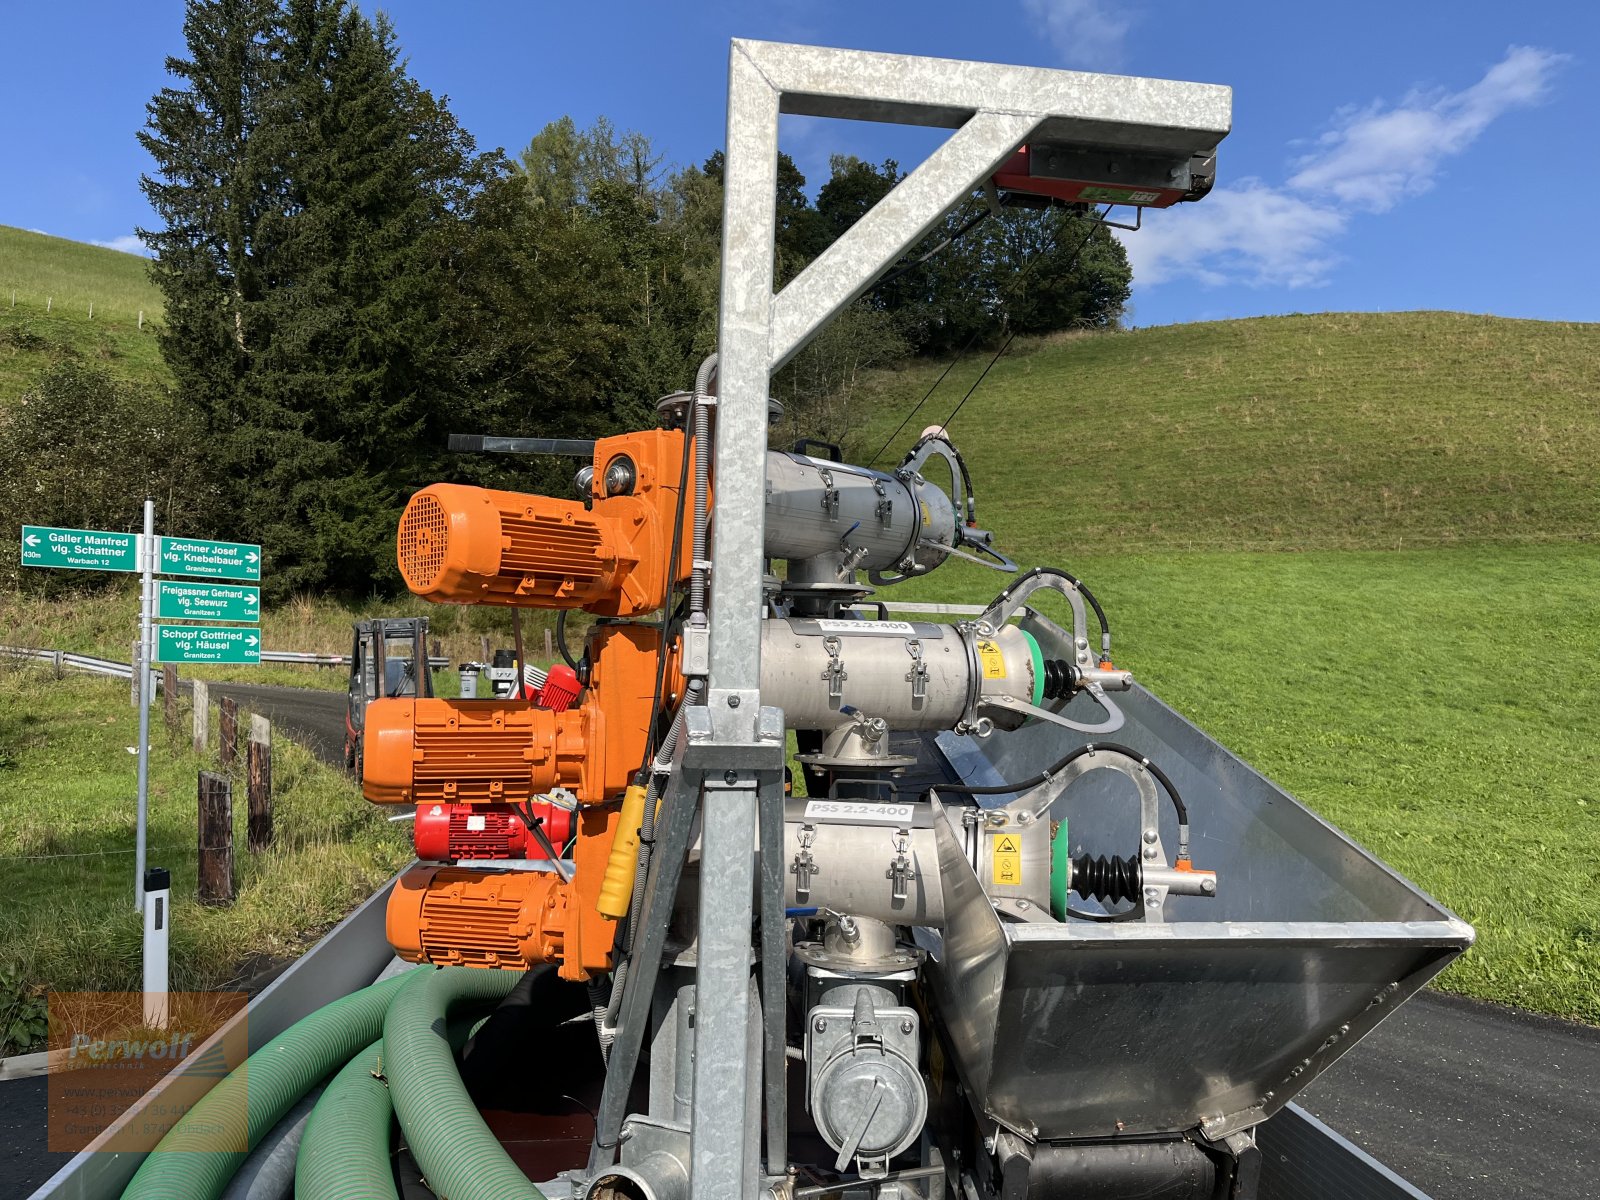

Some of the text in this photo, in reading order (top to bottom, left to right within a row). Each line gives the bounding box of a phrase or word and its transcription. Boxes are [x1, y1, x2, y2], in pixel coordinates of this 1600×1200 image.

[48, 533, 128, 546] Galler Manfred
[51, 544, 126, 556] vlg. Schattner
[170, 542, 237, 555] Zechner Josef
[164, 552, 243, 566] vlg. Knebelbauer
[162, 586, 242, 598] Freigassner Gerhard
[178, 597, 228, 607] vlg. Seewurz
[853, 621, 908, 630] 2.2-400
[162, 630, 242, 640] Schopf Gottfried
[175, 640, 229, 650] vlg. Häusel
[811, 804, 908, 816] PSS 2.2-400
